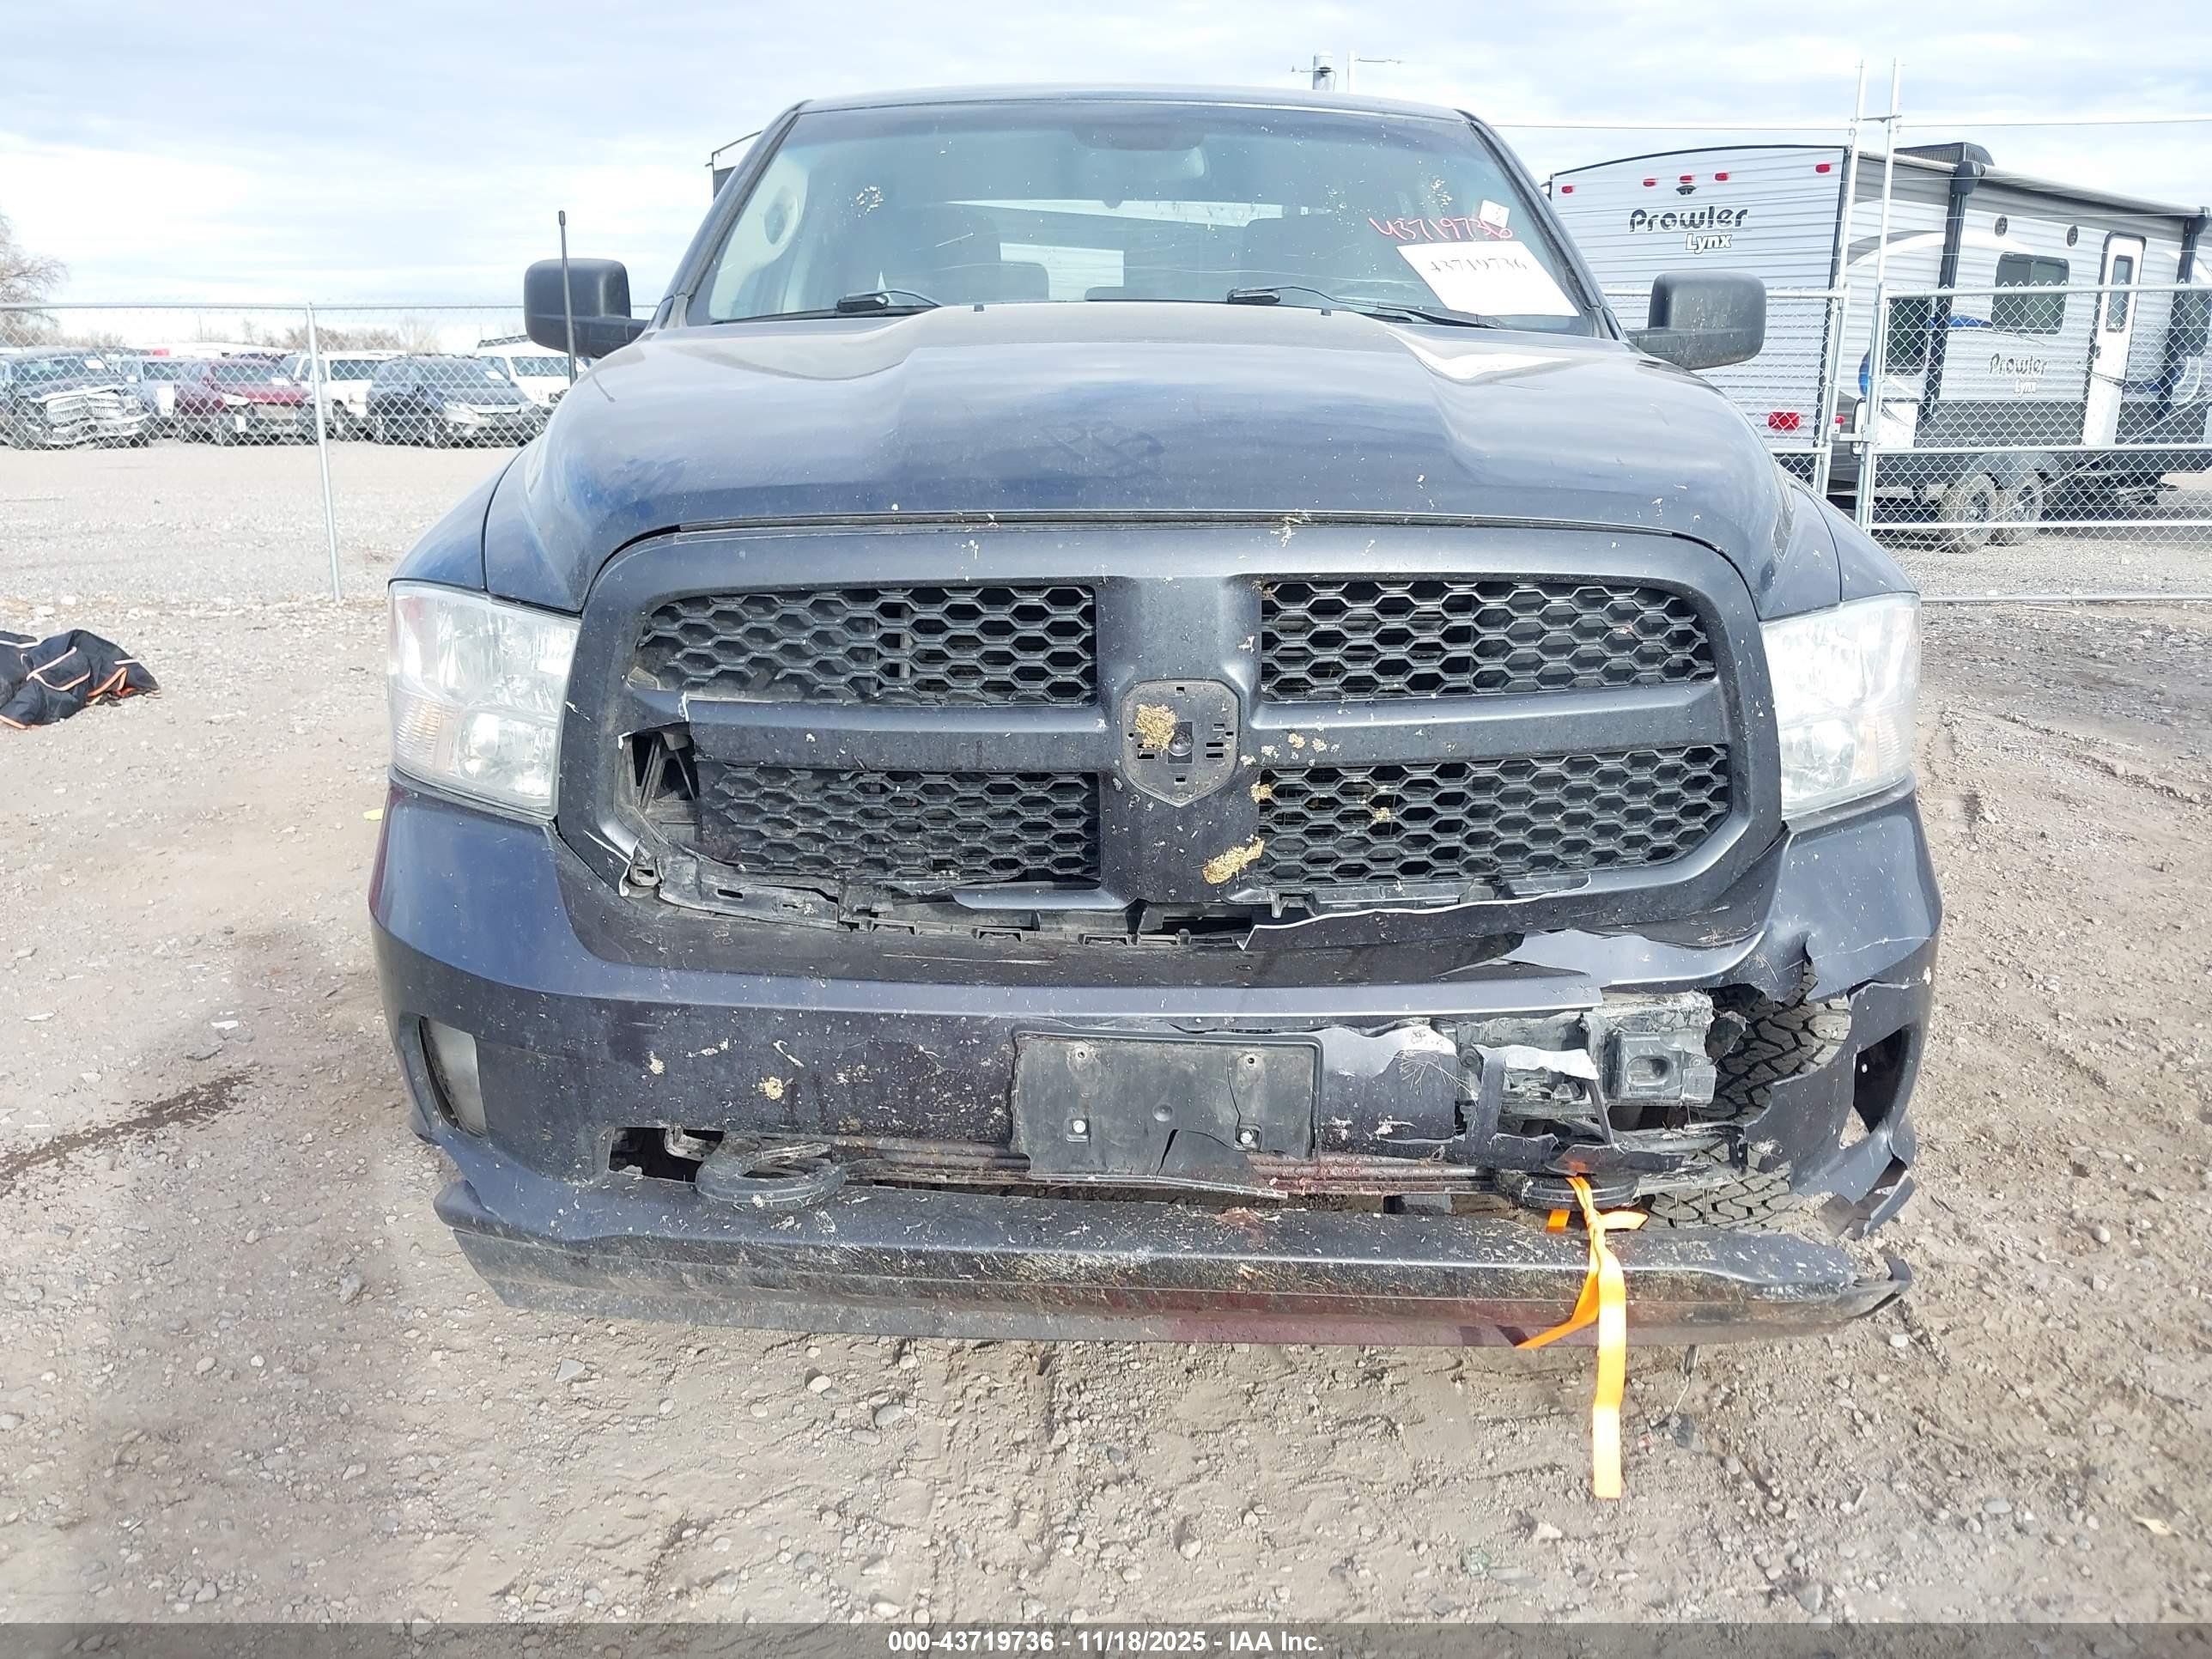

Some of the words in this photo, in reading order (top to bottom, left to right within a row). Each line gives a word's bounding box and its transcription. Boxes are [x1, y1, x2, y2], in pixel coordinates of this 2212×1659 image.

[1629, 205, 1748, 233] Prowler
[1686, 233, 1732, 254] Lynx
[1989, 353, 2048, 375] Prowler
